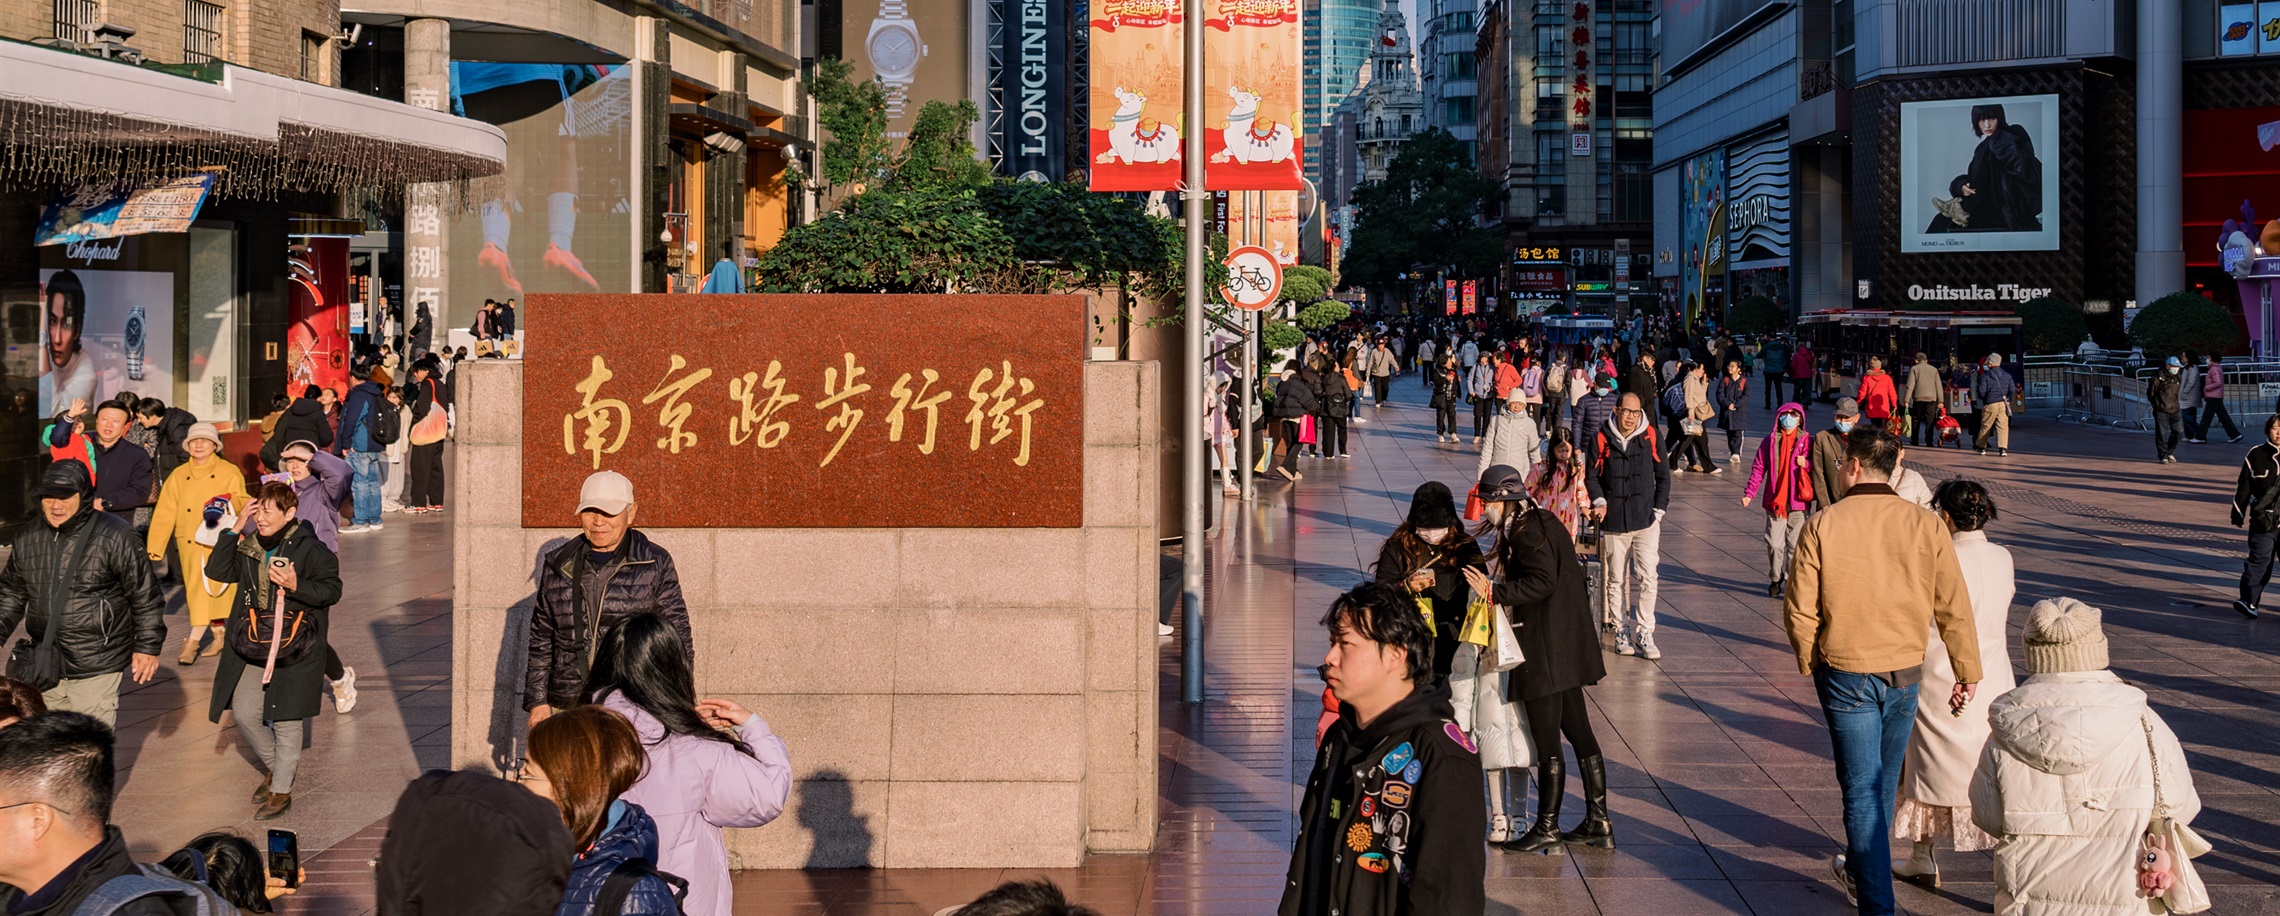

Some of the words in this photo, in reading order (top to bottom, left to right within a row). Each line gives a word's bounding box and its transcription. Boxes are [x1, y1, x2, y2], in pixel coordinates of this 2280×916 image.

[1021, 0, 1047, 156] LONGINE
[1217, 203, 1226, 219] First
[1730, 196, 1769, 230] SEPHORA
[66, 235, 125, 266] Chopard
[1519, 248, 1560, 260] 汤包馆
[1908, 284, 1996, 300] Onitsuka
[1997, 284, 2051, 304] Tiger
